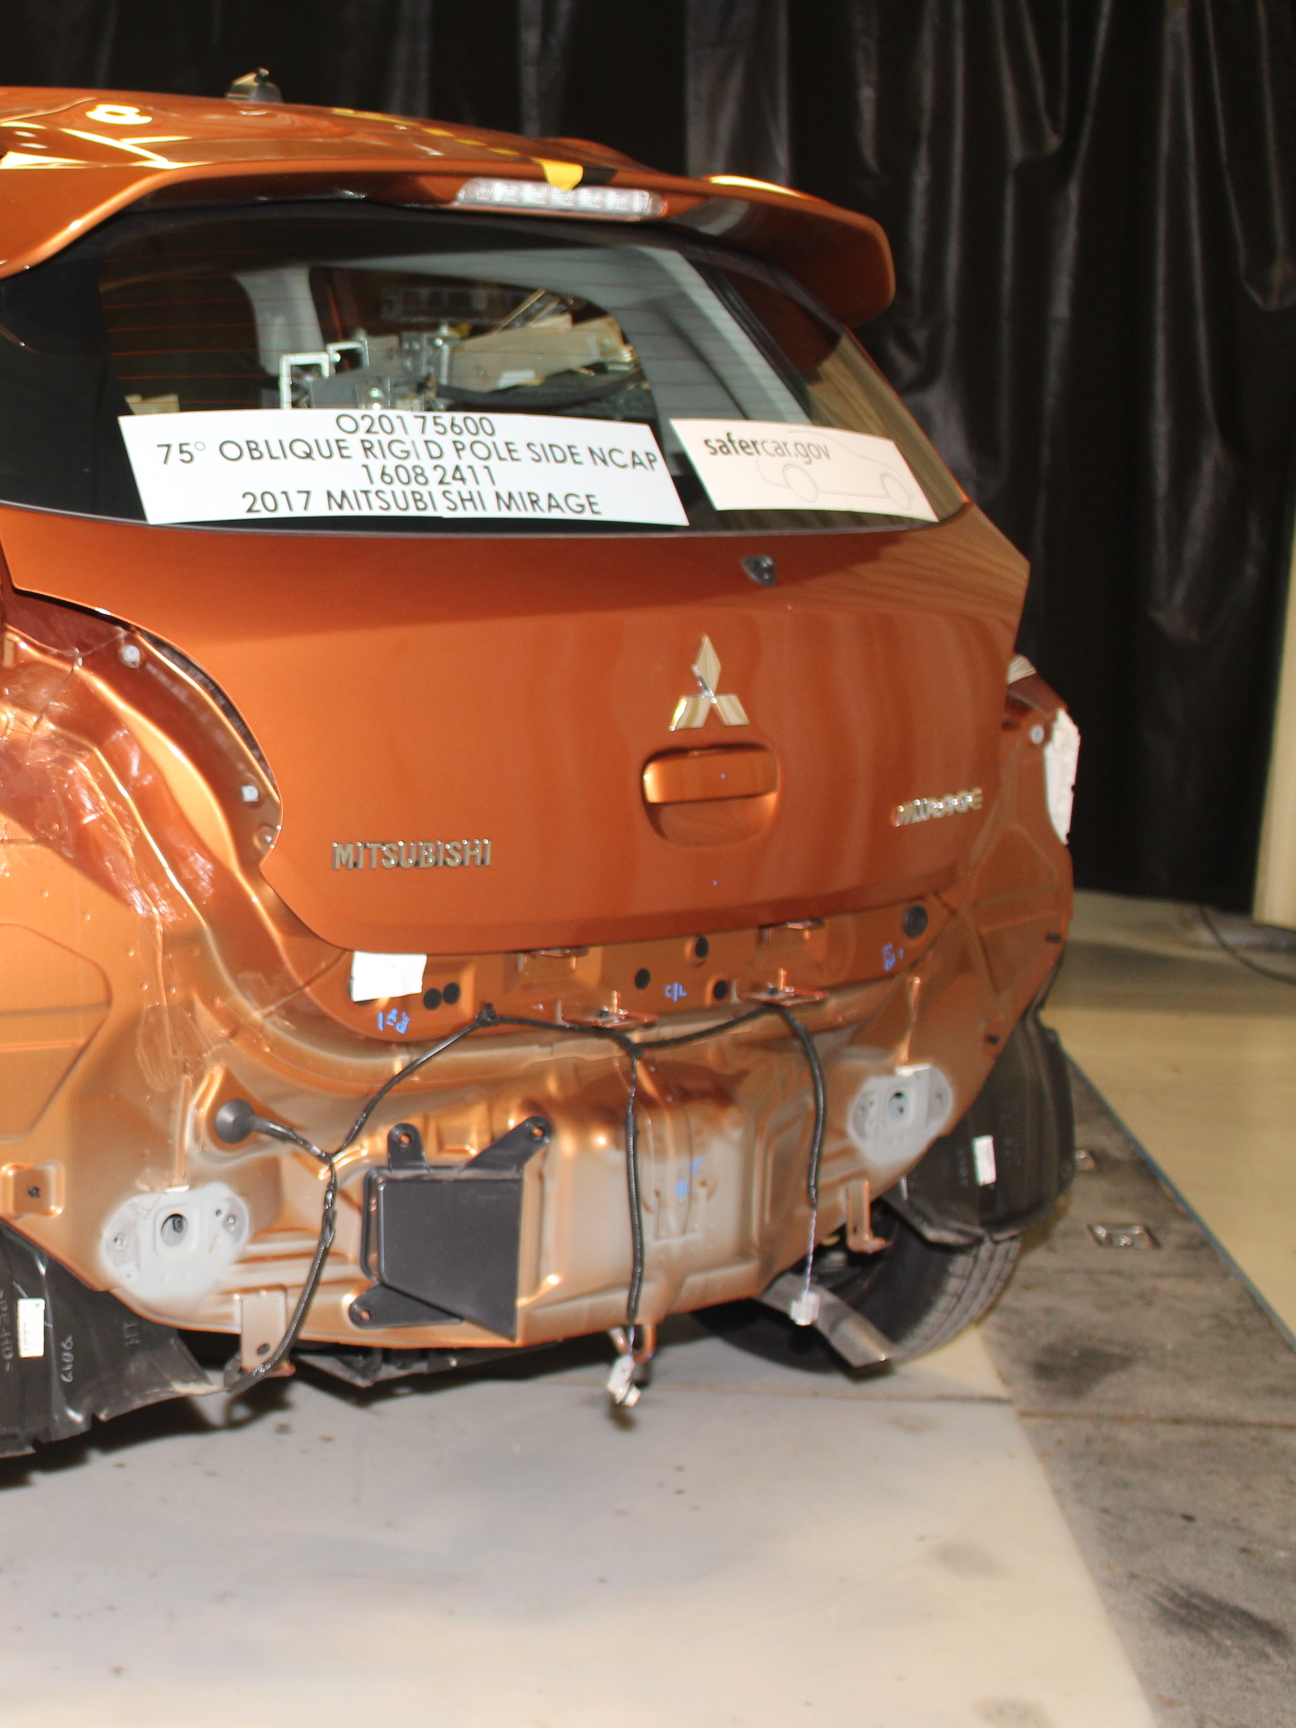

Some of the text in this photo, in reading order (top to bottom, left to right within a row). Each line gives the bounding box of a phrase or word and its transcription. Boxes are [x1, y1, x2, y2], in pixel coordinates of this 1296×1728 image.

[218, 438, 353, 462] OBLIQUE
[360, 438, 445, 461] RIGID
[452, 439, 522, 462] POLE
[526, 441, 585, 466] SIDE
[587, 445, 659, 472] NCAP
[704, 431, 831, 465] safercar.gov
[241, 489, 603, 516] 2017 MITSUBISHI MIRAGE
[332, 838, 493, 871] MITSUBISHI
